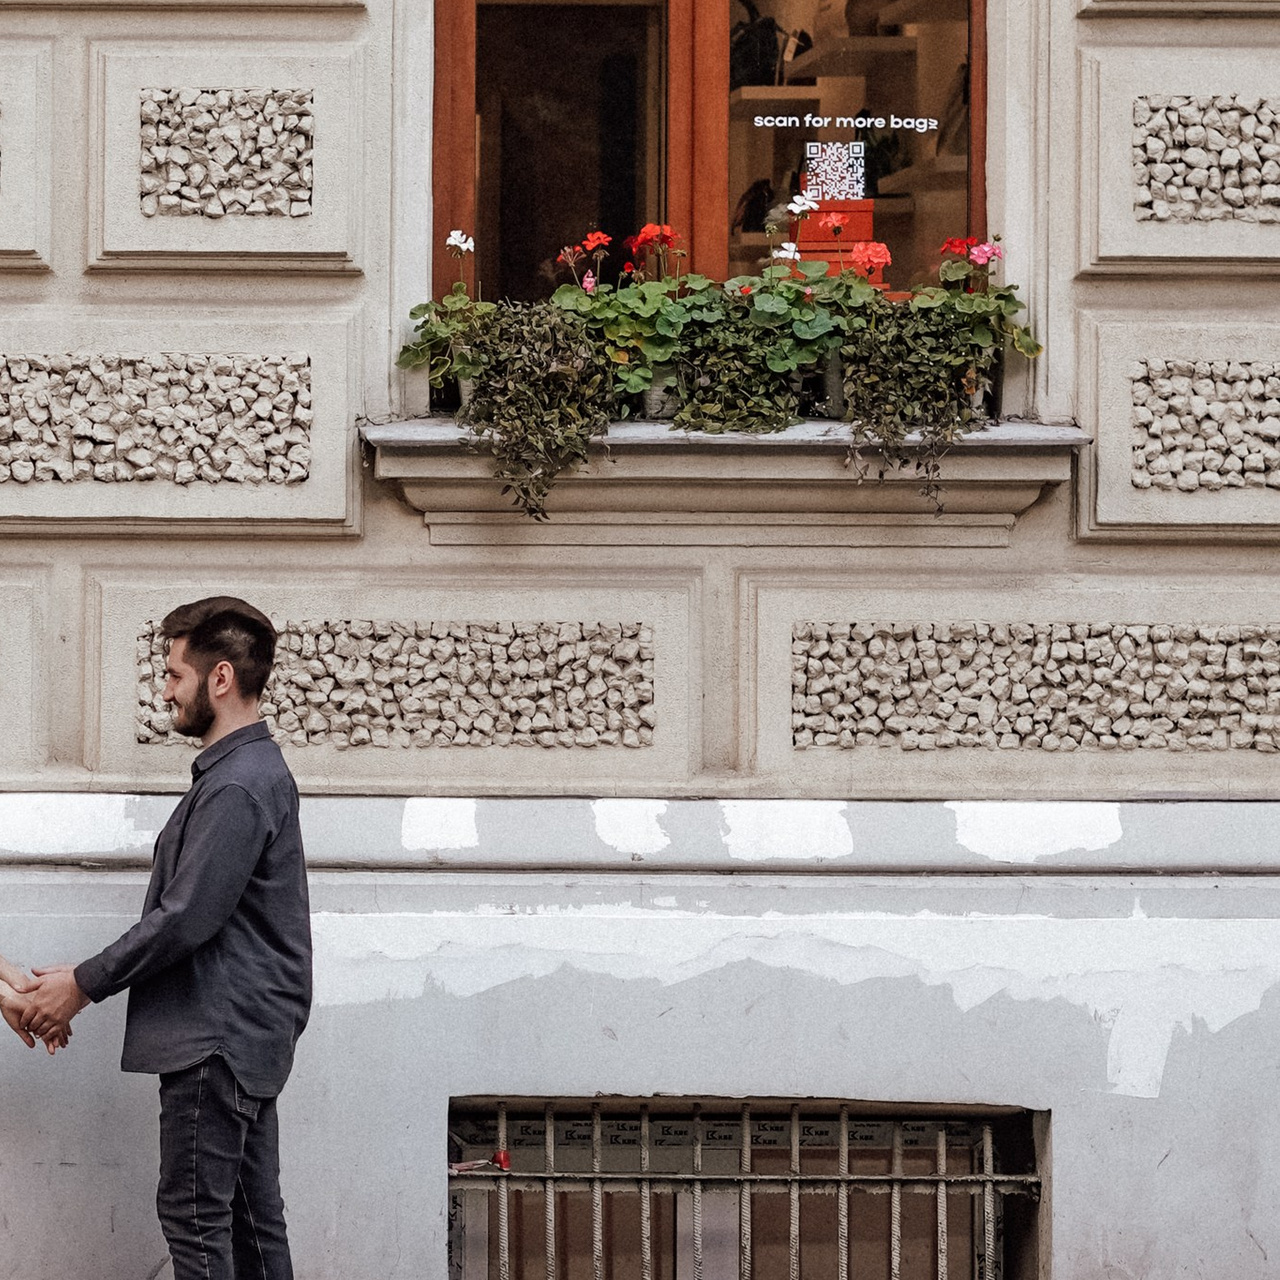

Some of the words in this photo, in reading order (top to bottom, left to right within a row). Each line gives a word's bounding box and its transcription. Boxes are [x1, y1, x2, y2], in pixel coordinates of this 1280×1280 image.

[753, 115, 800, 128] scan
[803, 113, 832, 128] for
[835, 116, 886, 129] more
[890, 114, 939, 133] bags
